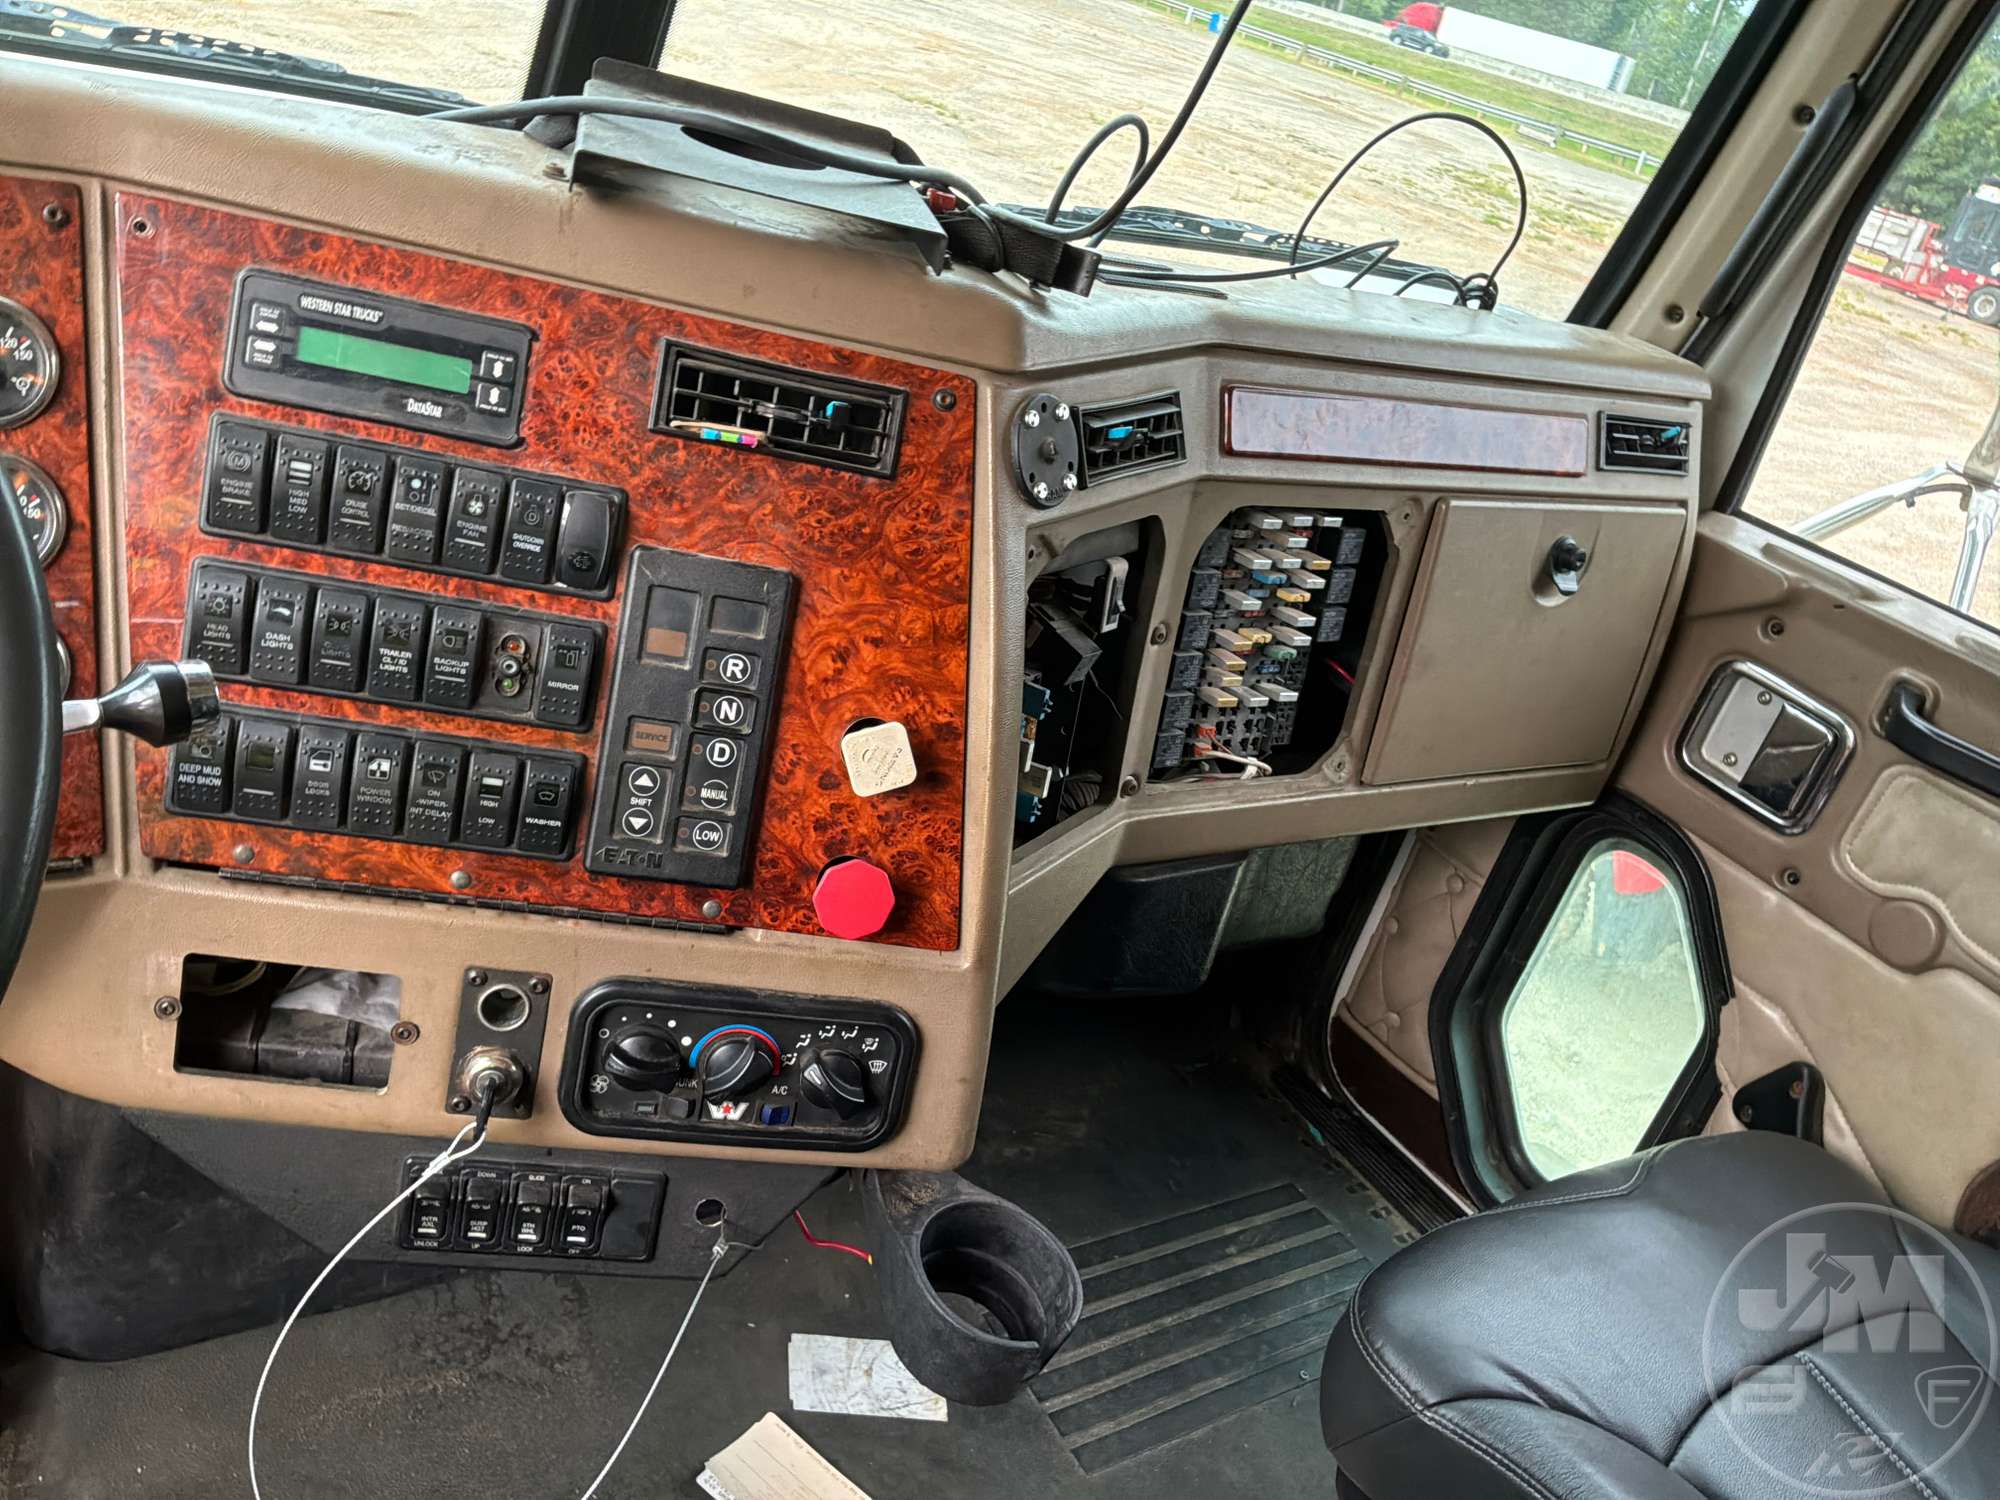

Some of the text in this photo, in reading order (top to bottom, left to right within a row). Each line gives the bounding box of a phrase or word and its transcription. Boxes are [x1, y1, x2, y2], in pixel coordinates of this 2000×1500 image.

[300, 295, 334, 314] WESTERN
[333, 302, 352, 317] STAR
[352, 306, 381, 323] TRUCKS
[13, 349, 33, 361] 150
[288, 489, 310, 498] HIGH
[289, 497, 308, 506] MED
[288, 505, 308, 514] LOW
[456, 520, 489, 533] ENGINE
[462, 530, 480, 538] FAN
[207, 623, 229, 632] HEAD
[203, 630, 231, 640] LIGHTS
[265, 632, 291, 642] DASH
[260, 640, 294, 650] LIGHTS
[379, 647, 412, 658] TRAILER
[433, 657, 470, 668] BACKUP
[379, 664, 409, 673] LIGHTS
[435, 665, 467, 675] LIGHTS
[726, 658, 744, 679] R
[547, 681, 579, 691] MIRROR
[719, 701, 738, 721] N
[635, 730, 668, 743] SERVICE
[713, 743, 730, 762] D
[179, 763, 222, 776] DEEP MUD
[178, 774, 222, 787] AND SNOW
[427, 789, 441, 797] ON
[700, 787, 728, 801] MANUAL
[480, 800, 499, 808] HIGH
[630, 796, 653, 807] SHIFT
[426, 809, 452, 819] DELAY
[478, 816, 496, 825] LOW
[525, 816, 562, 827] WASHER
[695, 829, 720, 842] LOW
[676, 1079, 699, 1089] UNK
[771, 1084, 789, 1096] A/C
